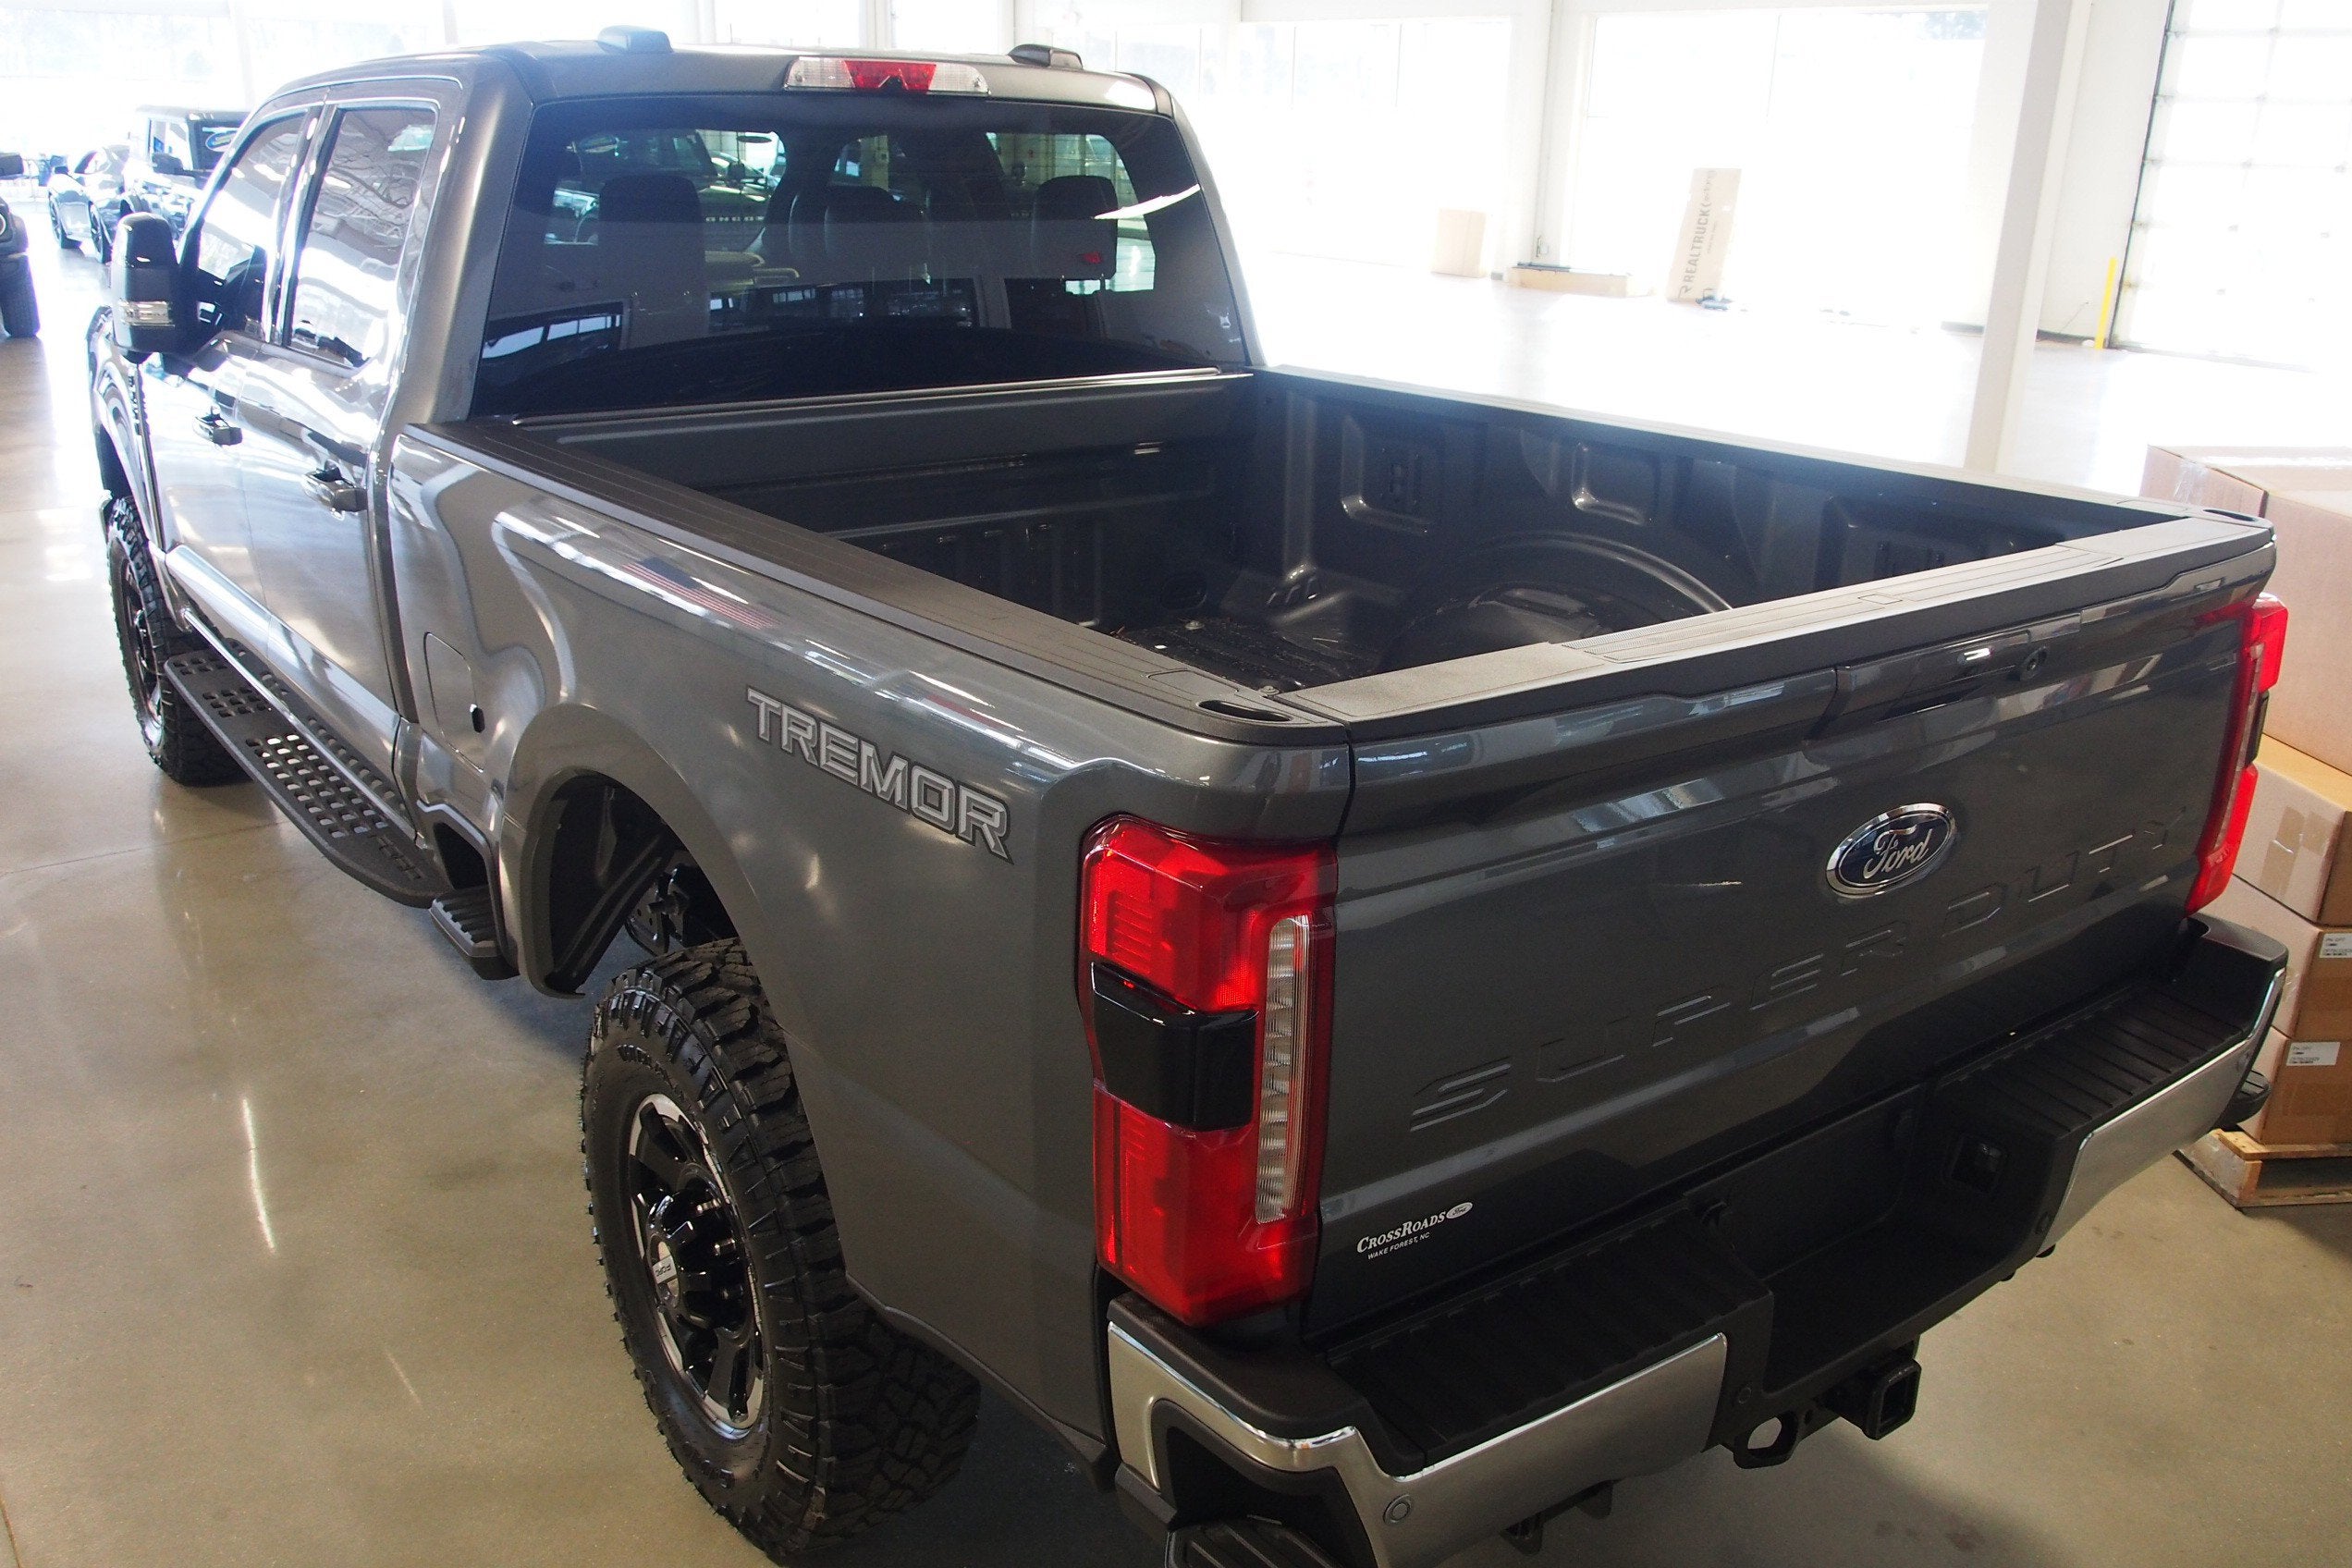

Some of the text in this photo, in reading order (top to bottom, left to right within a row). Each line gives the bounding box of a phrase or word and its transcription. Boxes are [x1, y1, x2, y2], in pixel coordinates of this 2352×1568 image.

[1683, 209, 1710, 283] REALTRUCK
[746, 685, 1014, 864] TREMOR
[1862, 824, 1933, 879] Ford
[1409, 922, 1908, 1132] SUPER
[1367, 1231, 1430, 1260] WAKE FOREST, NC
